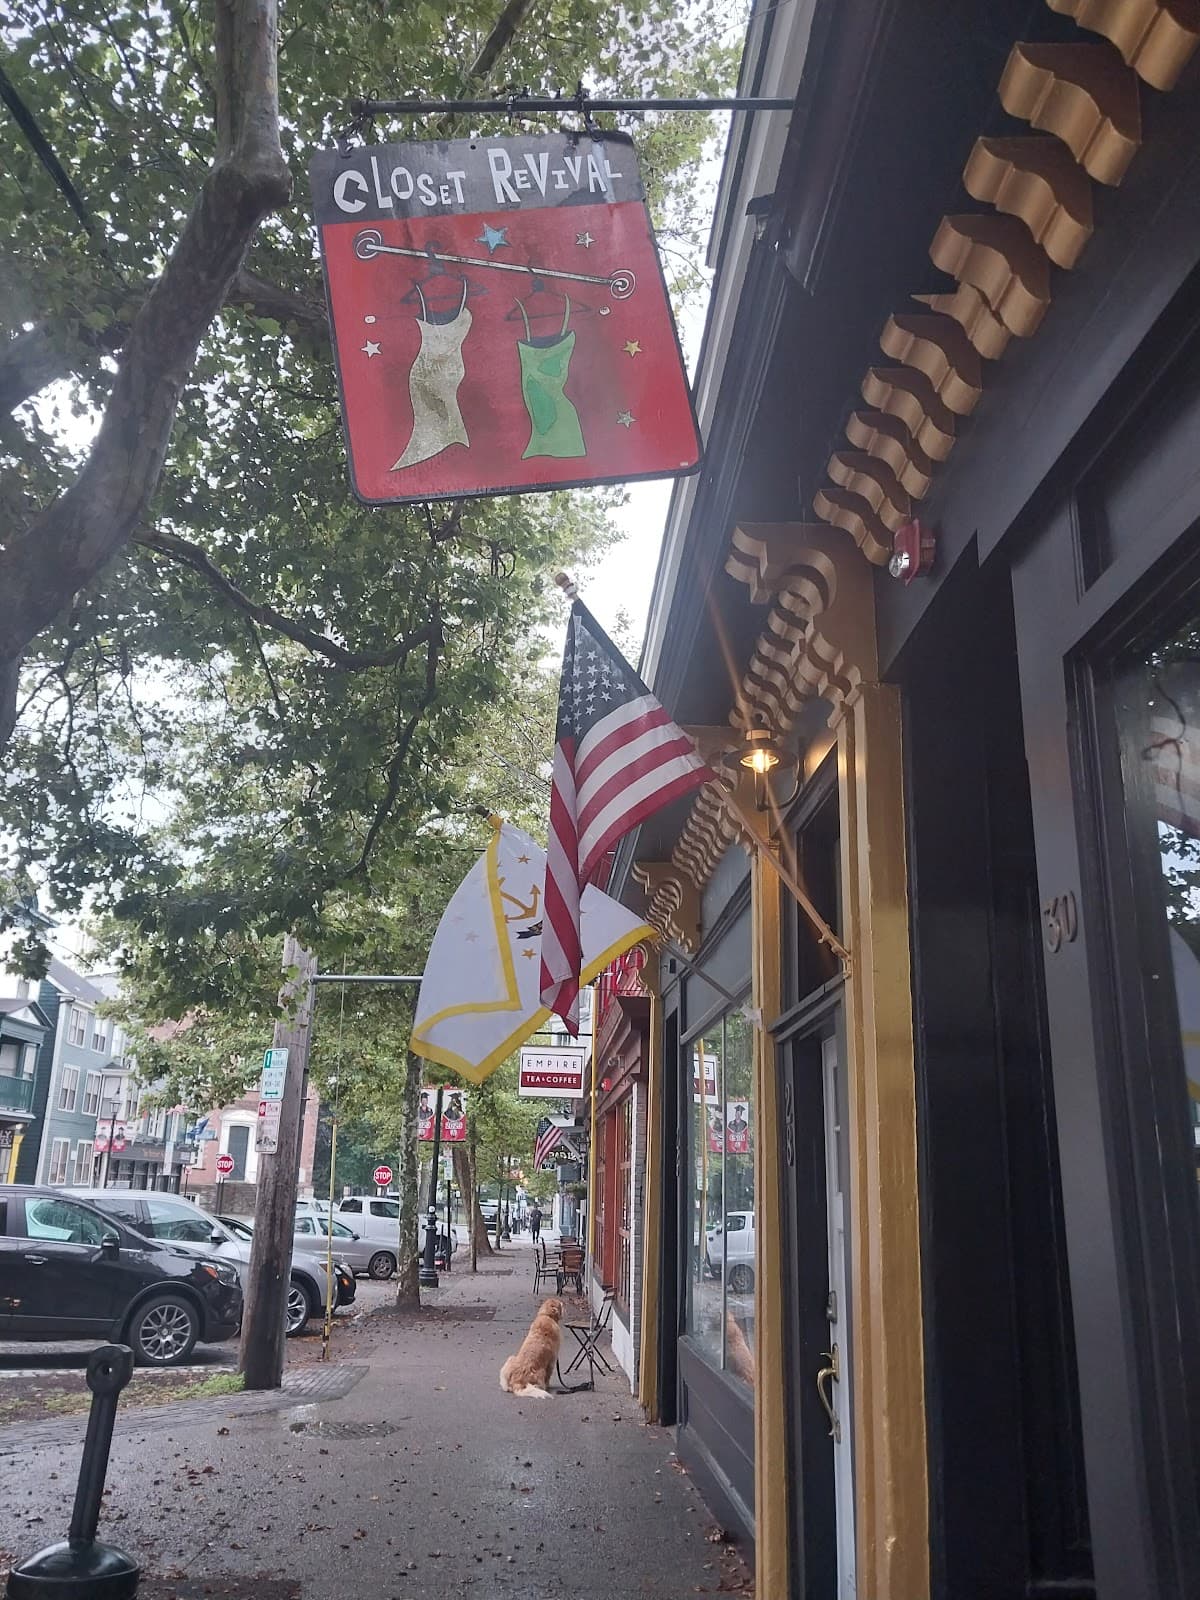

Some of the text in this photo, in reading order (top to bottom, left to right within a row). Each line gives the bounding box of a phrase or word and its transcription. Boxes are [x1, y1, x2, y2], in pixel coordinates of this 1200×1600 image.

[333, 148, 623, 213] CLOSET REVIVAL
[1042, 890, 1078, 953] 30
[527, 1059, 577, 1069] EMPIRE
[217, 1160, 233, 1169] STOP
[375, 1171, 391, 1180] STOP
